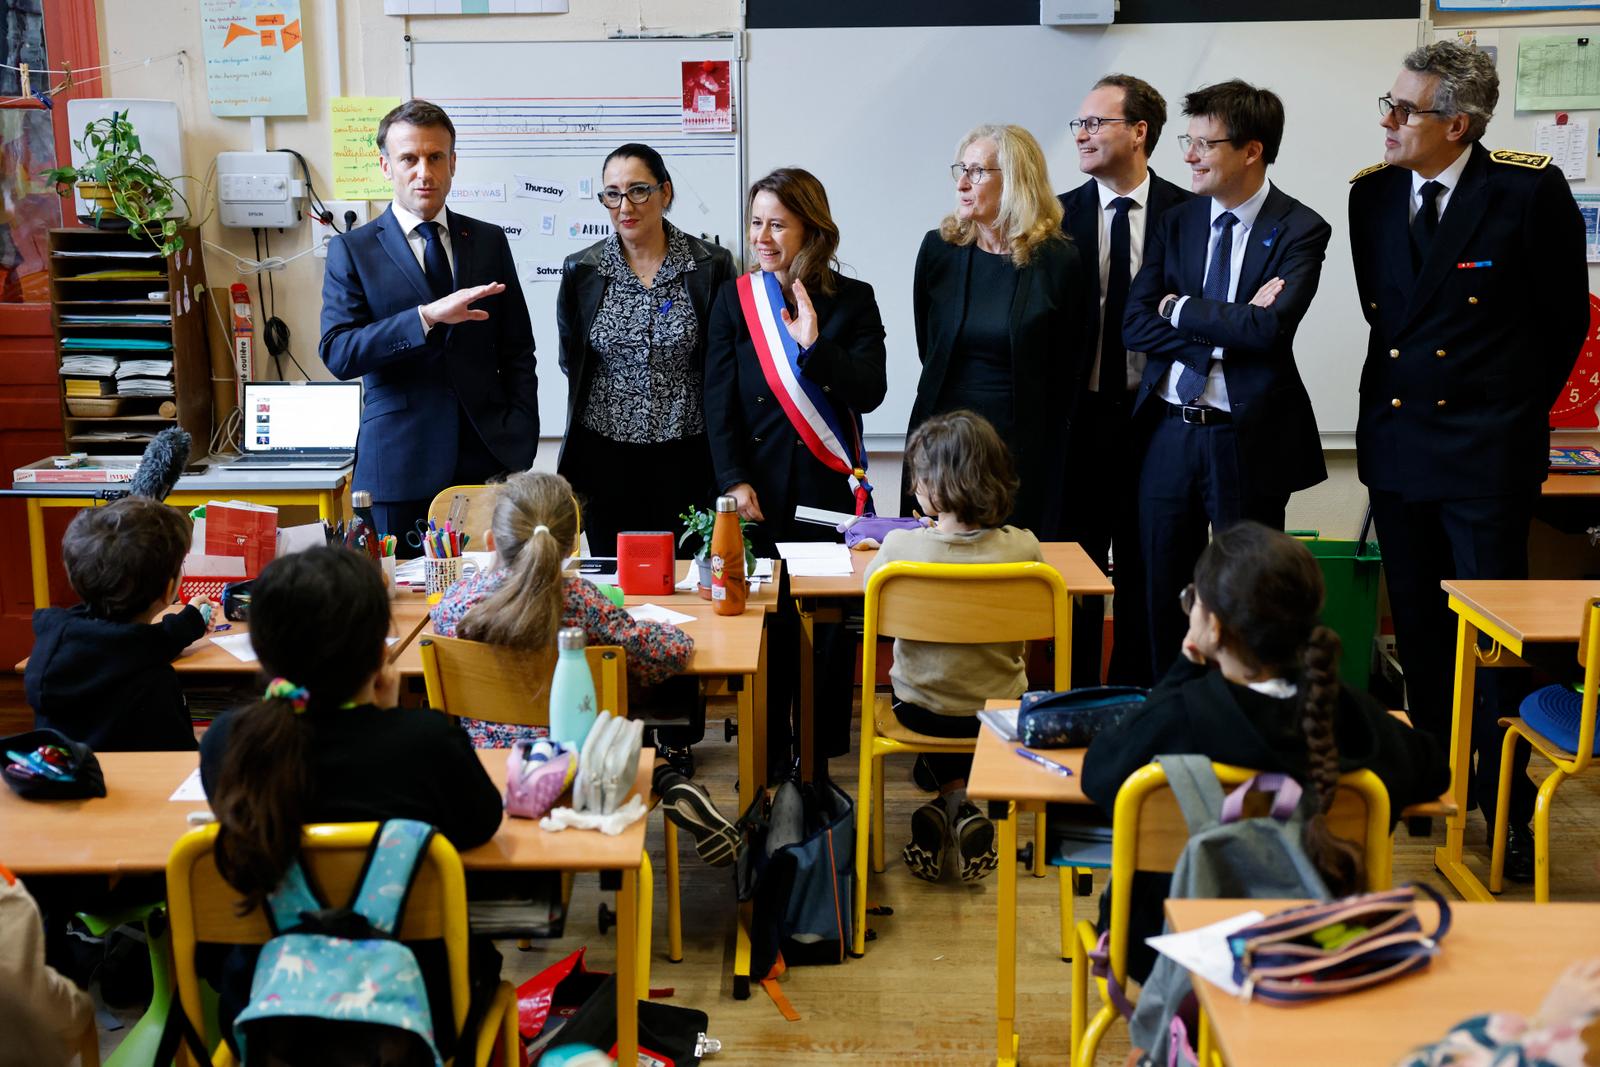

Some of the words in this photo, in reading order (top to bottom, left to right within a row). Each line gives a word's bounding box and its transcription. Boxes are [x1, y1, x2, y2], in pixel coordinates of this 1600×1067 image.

[525, 182, 564, 197] Thursday
[543, 215, 553, 230] 5
[582, 224, 609, 235] APRIL
[240, 341, 248, 372] routière
[1589, 371, 1600, 386] 4
[1569, 388, 1580, 403] 5
